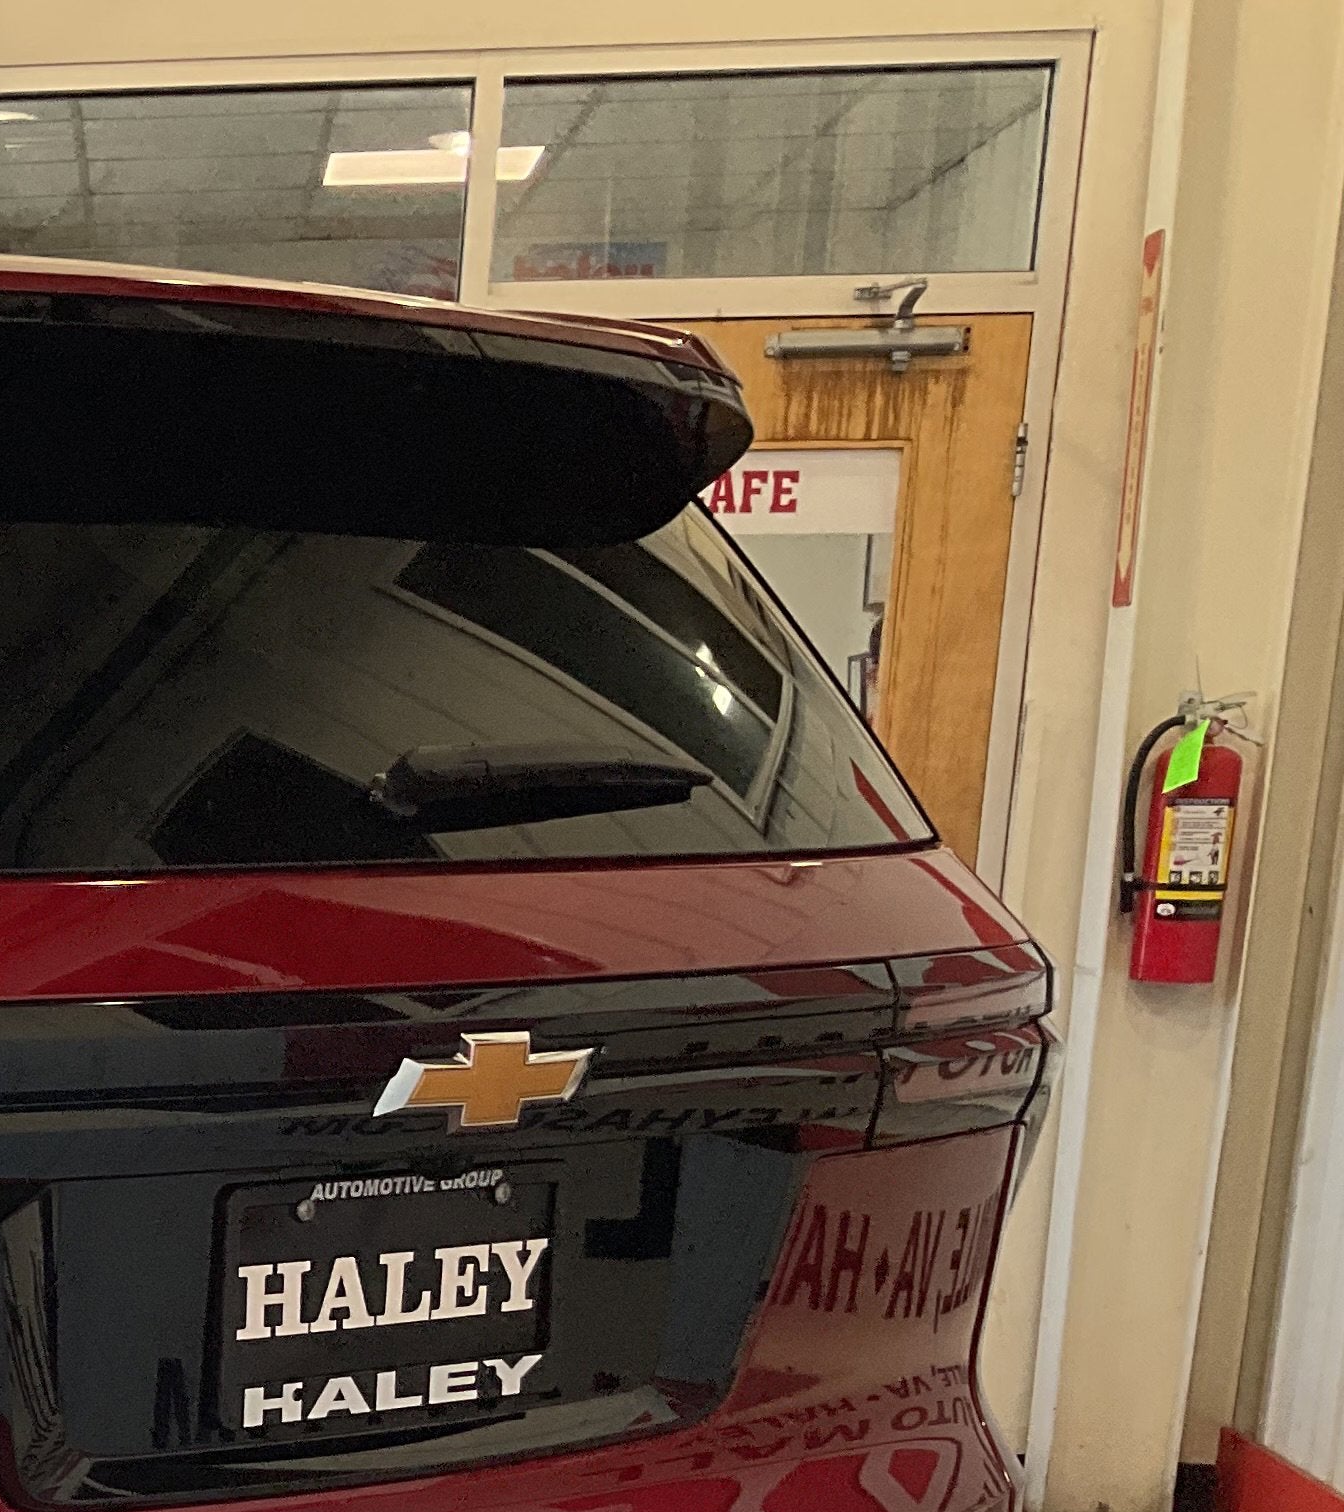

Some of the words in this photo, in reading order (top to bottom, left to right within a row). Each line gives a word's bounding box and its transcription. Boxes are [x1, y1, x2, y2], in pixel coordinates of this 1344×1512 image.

[701, 470, 800, 514] AFE
[310, 1175, 436, 1201] AUTOMOTIVE
[236, 1237, 549, 1341] HALEY
[243, 1354, 543, 1428] HALEY
